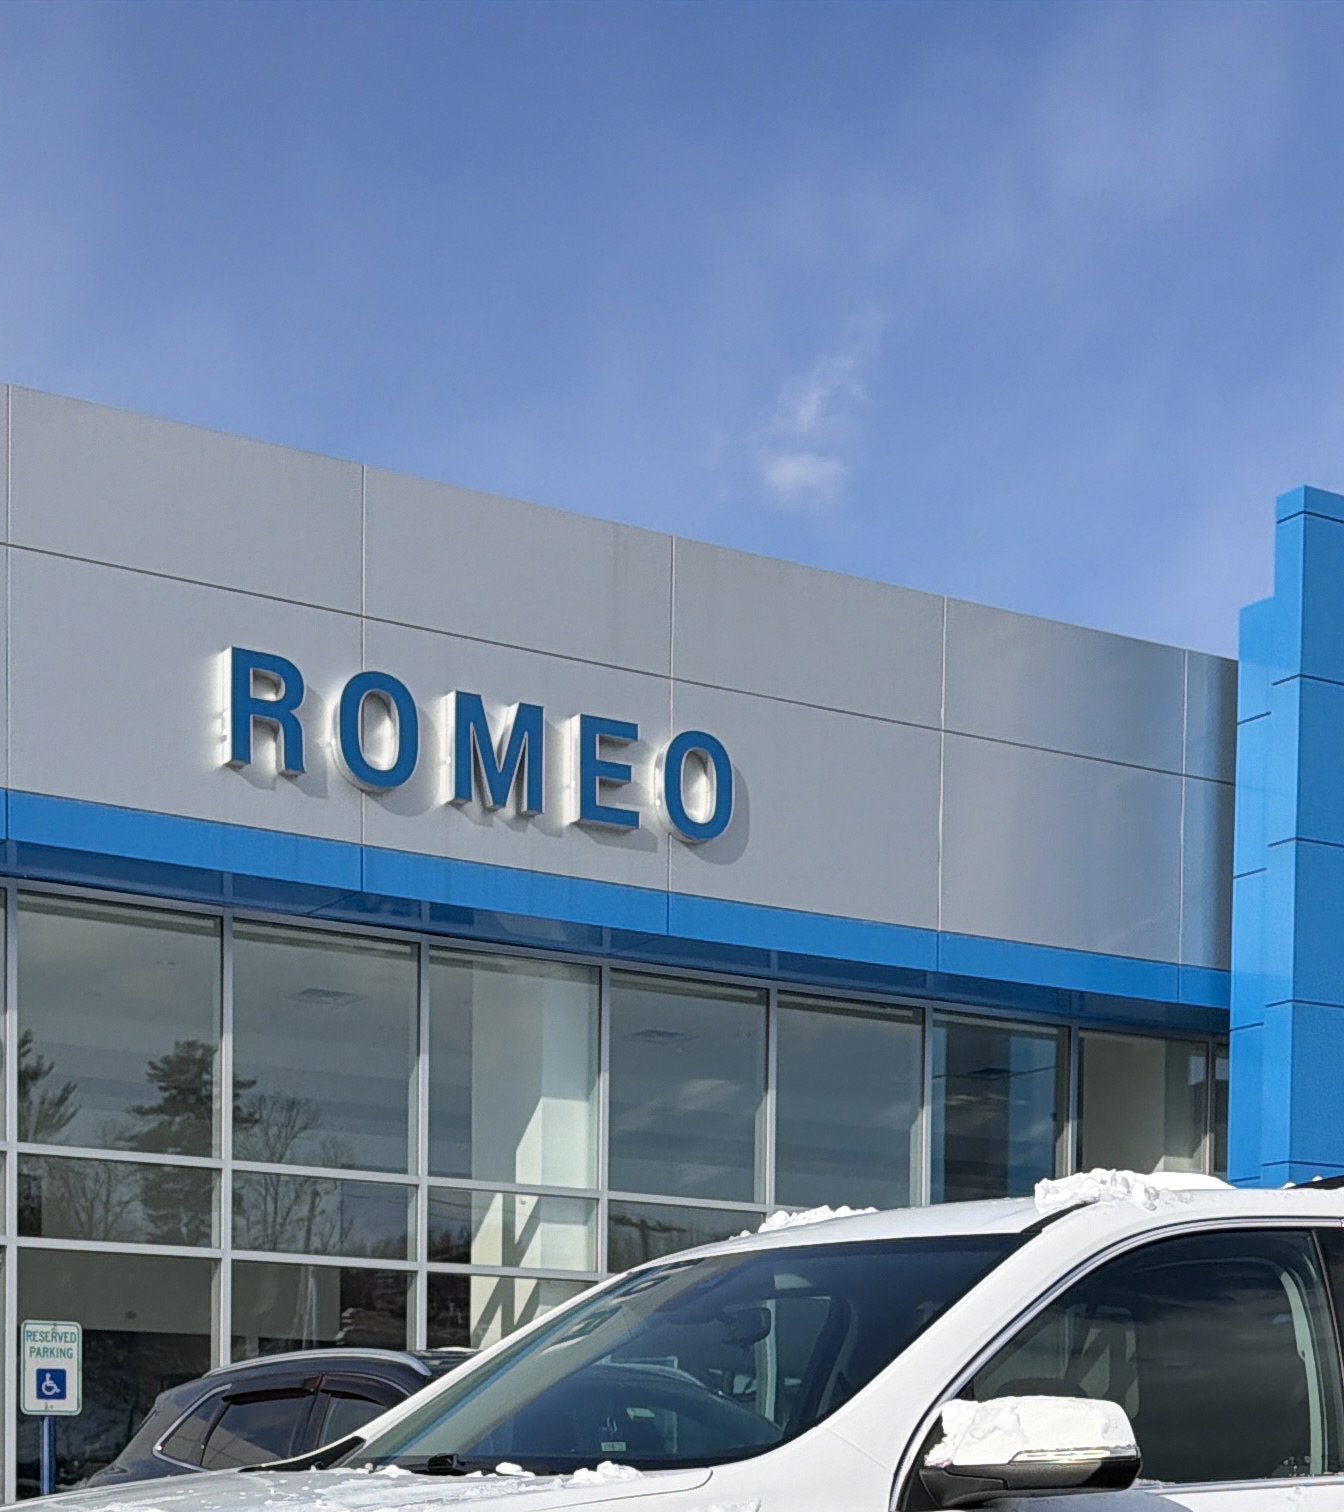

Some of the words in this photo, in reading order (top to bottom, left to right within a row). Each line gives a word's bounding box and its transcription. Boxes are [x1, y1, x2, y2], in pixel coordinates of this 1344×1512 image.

[226, 645, 735, 843] ROMEO
[25, 1330, 77, 1343] RESERVED
[29, 1346, 74, 1359] PARKING
